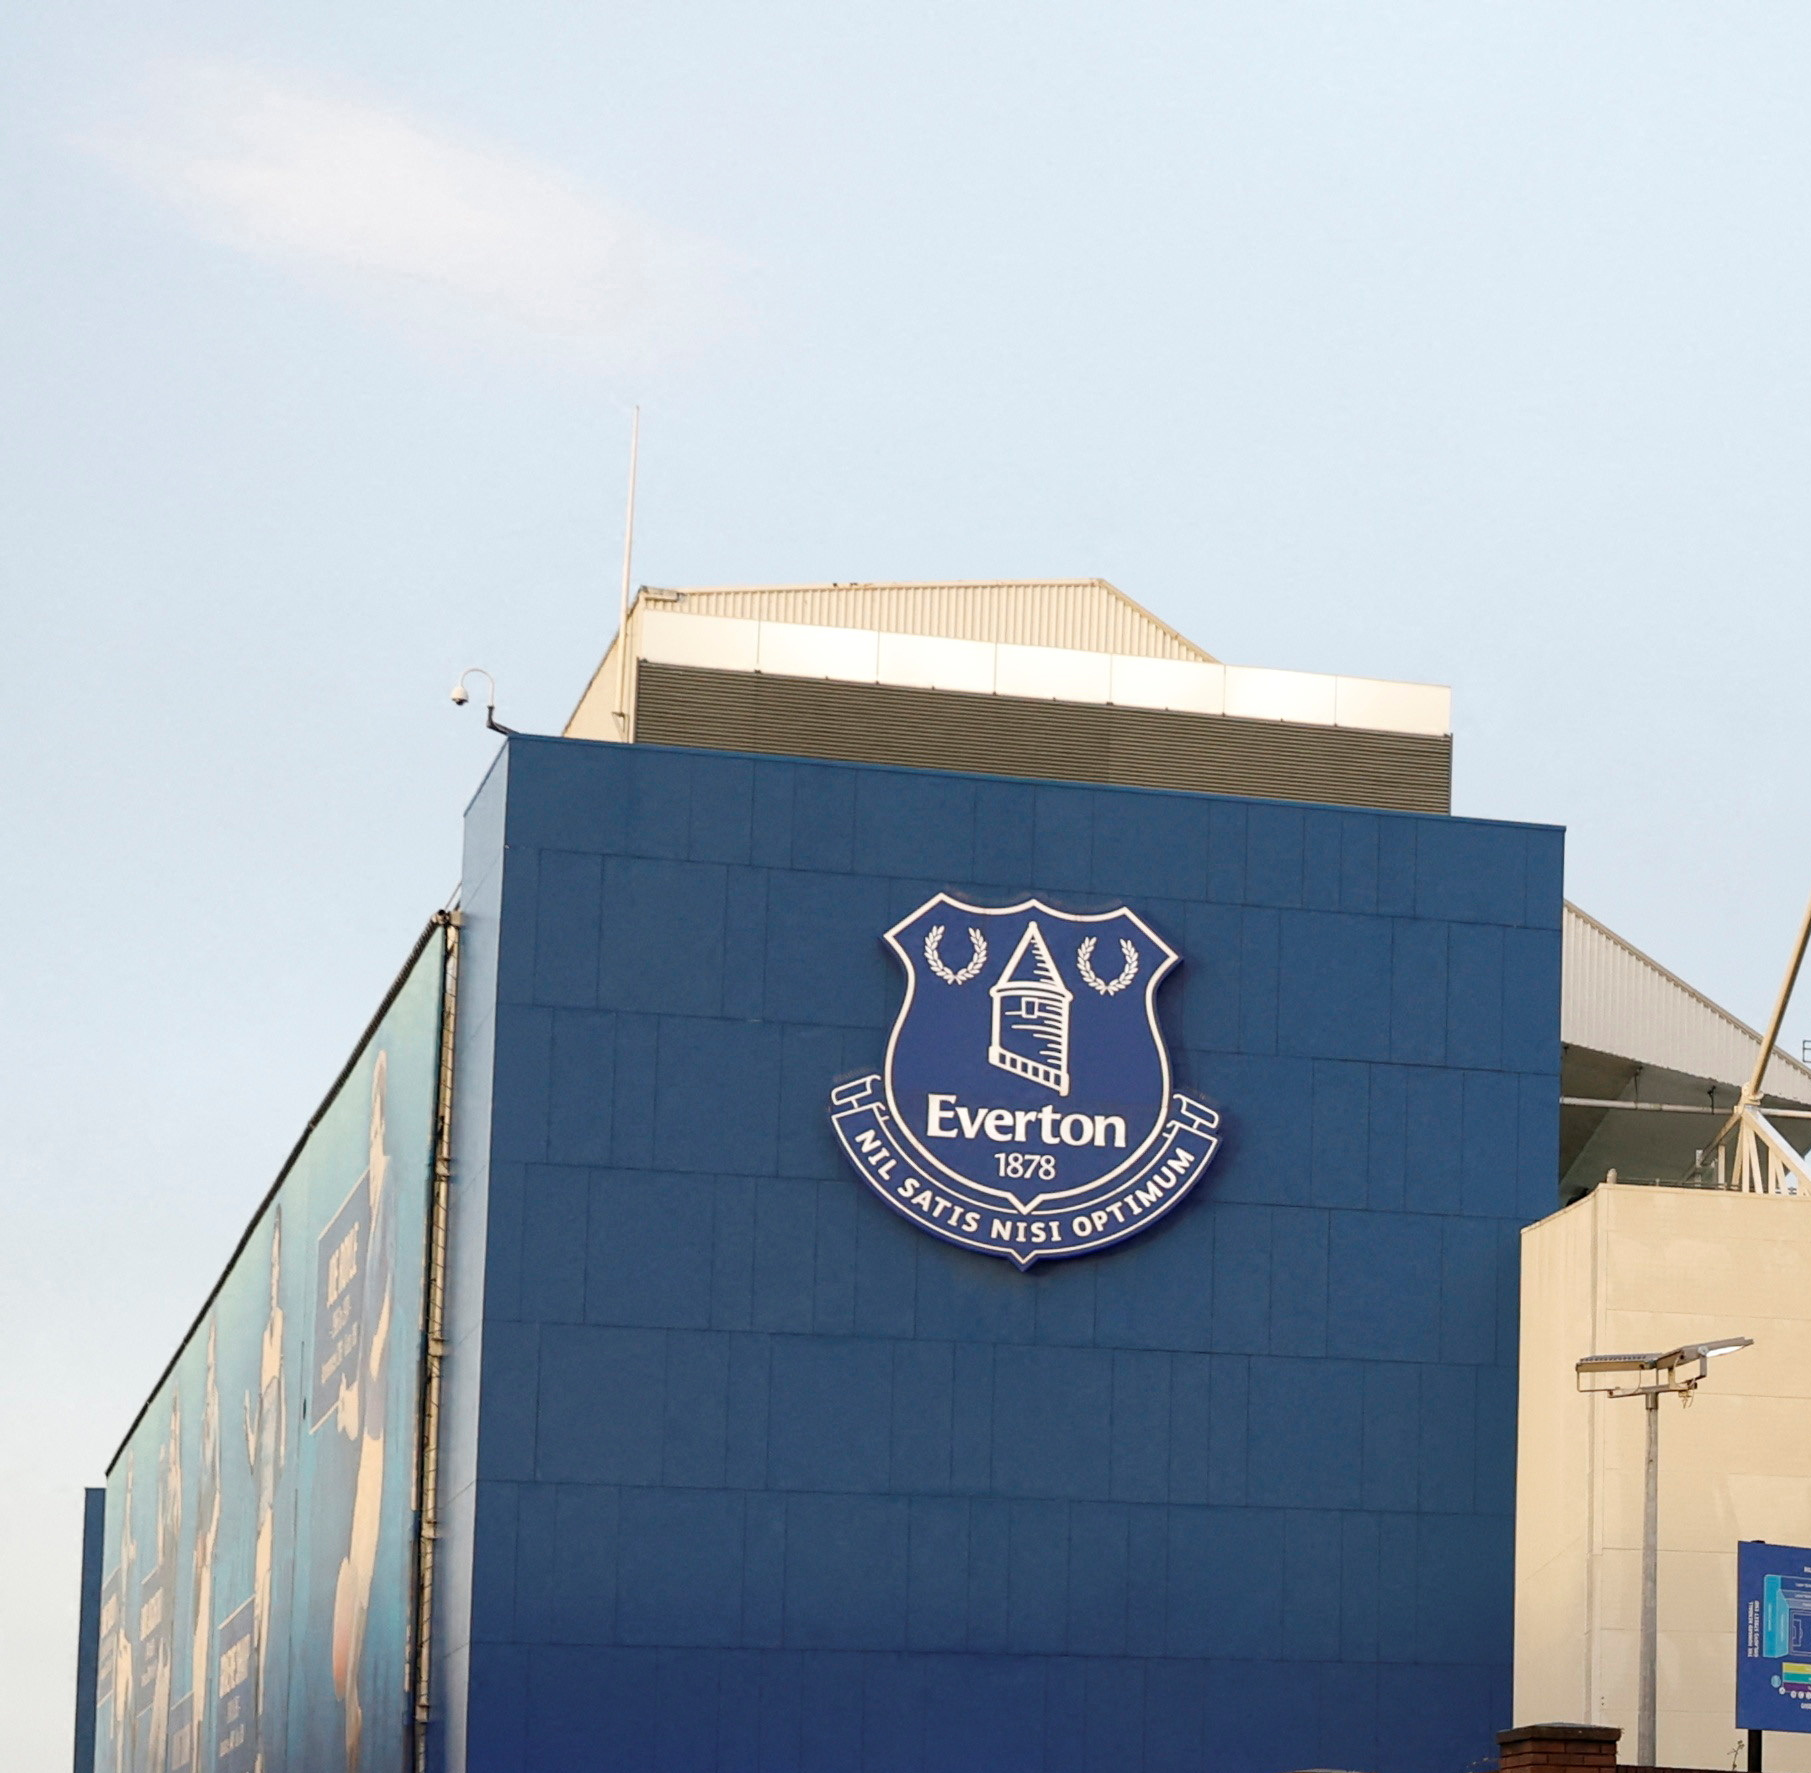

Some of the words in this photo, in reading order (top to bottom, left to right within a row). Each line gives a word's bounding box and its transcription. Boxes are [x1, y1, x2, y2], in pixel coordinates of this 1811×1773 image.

[926, 1093, 1127, 1148] Everton
[855, 1129, 892, 1182] NIL
[897, 1177, 981, 1233] SATIS
[990, 1220, 1062, 1242] NISI
[1072, 1146, 1196, 1238] OPTIMUM
[993, 1152, 1057, 1181] 1878
